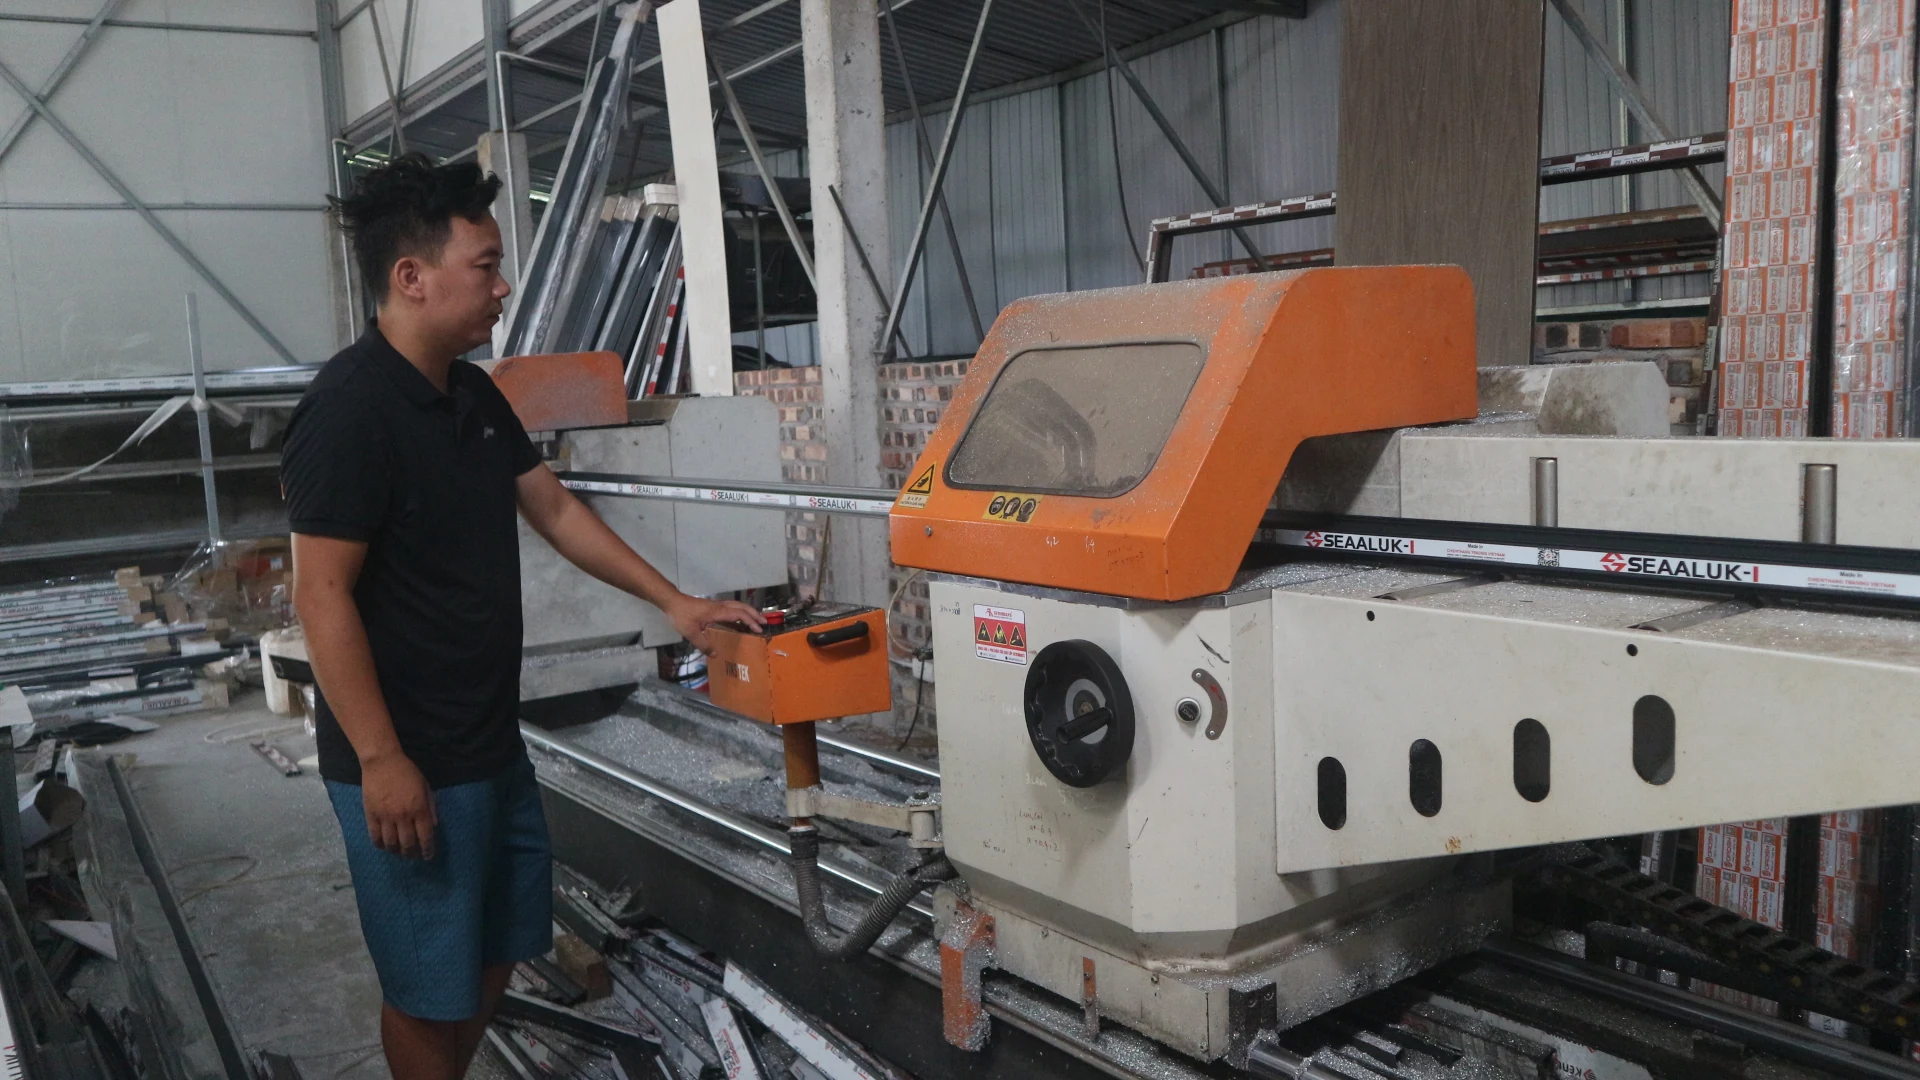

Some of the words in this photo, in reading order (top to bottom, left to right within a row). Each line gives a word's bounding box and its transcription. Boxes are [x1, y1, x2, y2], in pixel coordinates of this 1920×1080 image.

[717, 491, 749, 501] SEAALUK-I
[817, 498, 857, 510] SEAALUK-I
[1323, 534, 1415, 554] SEAALUK-I
[1627, 556, 1759, 583] SEAALUK-I
